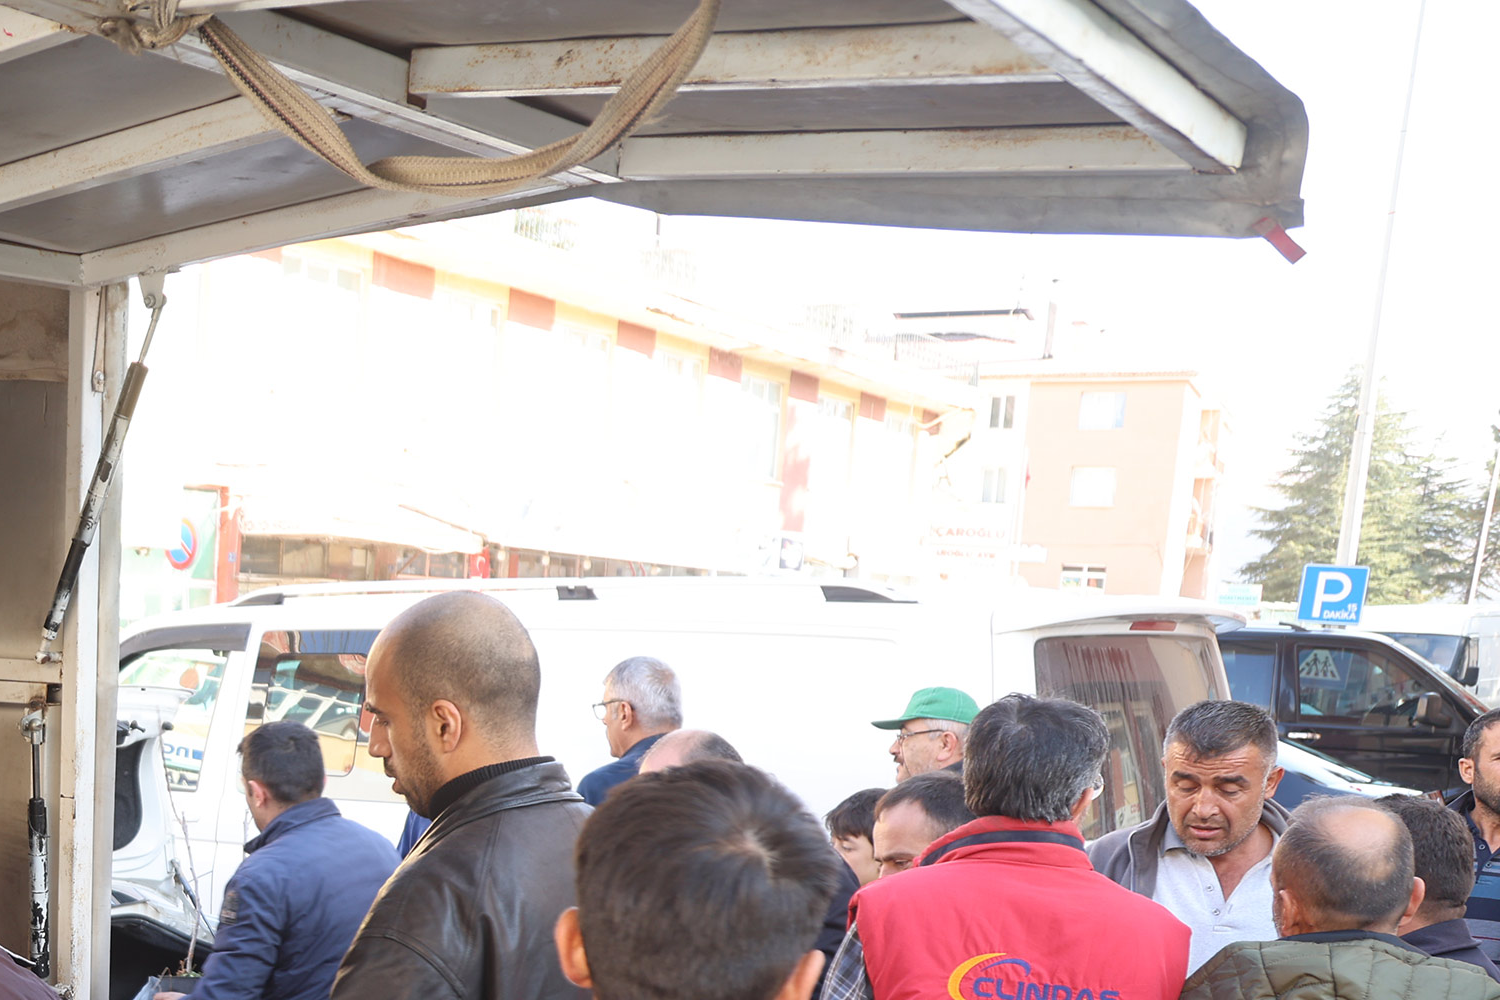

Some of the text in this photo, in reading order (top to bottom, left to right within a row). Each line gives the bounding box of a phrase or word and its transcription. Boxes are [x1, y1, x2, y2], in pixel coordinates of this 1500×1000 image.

[1312, 571, 1352, 618] P
[1348, 603, 1358, 612] 15
[1323, 609, 1357, 620] DAKİKA
